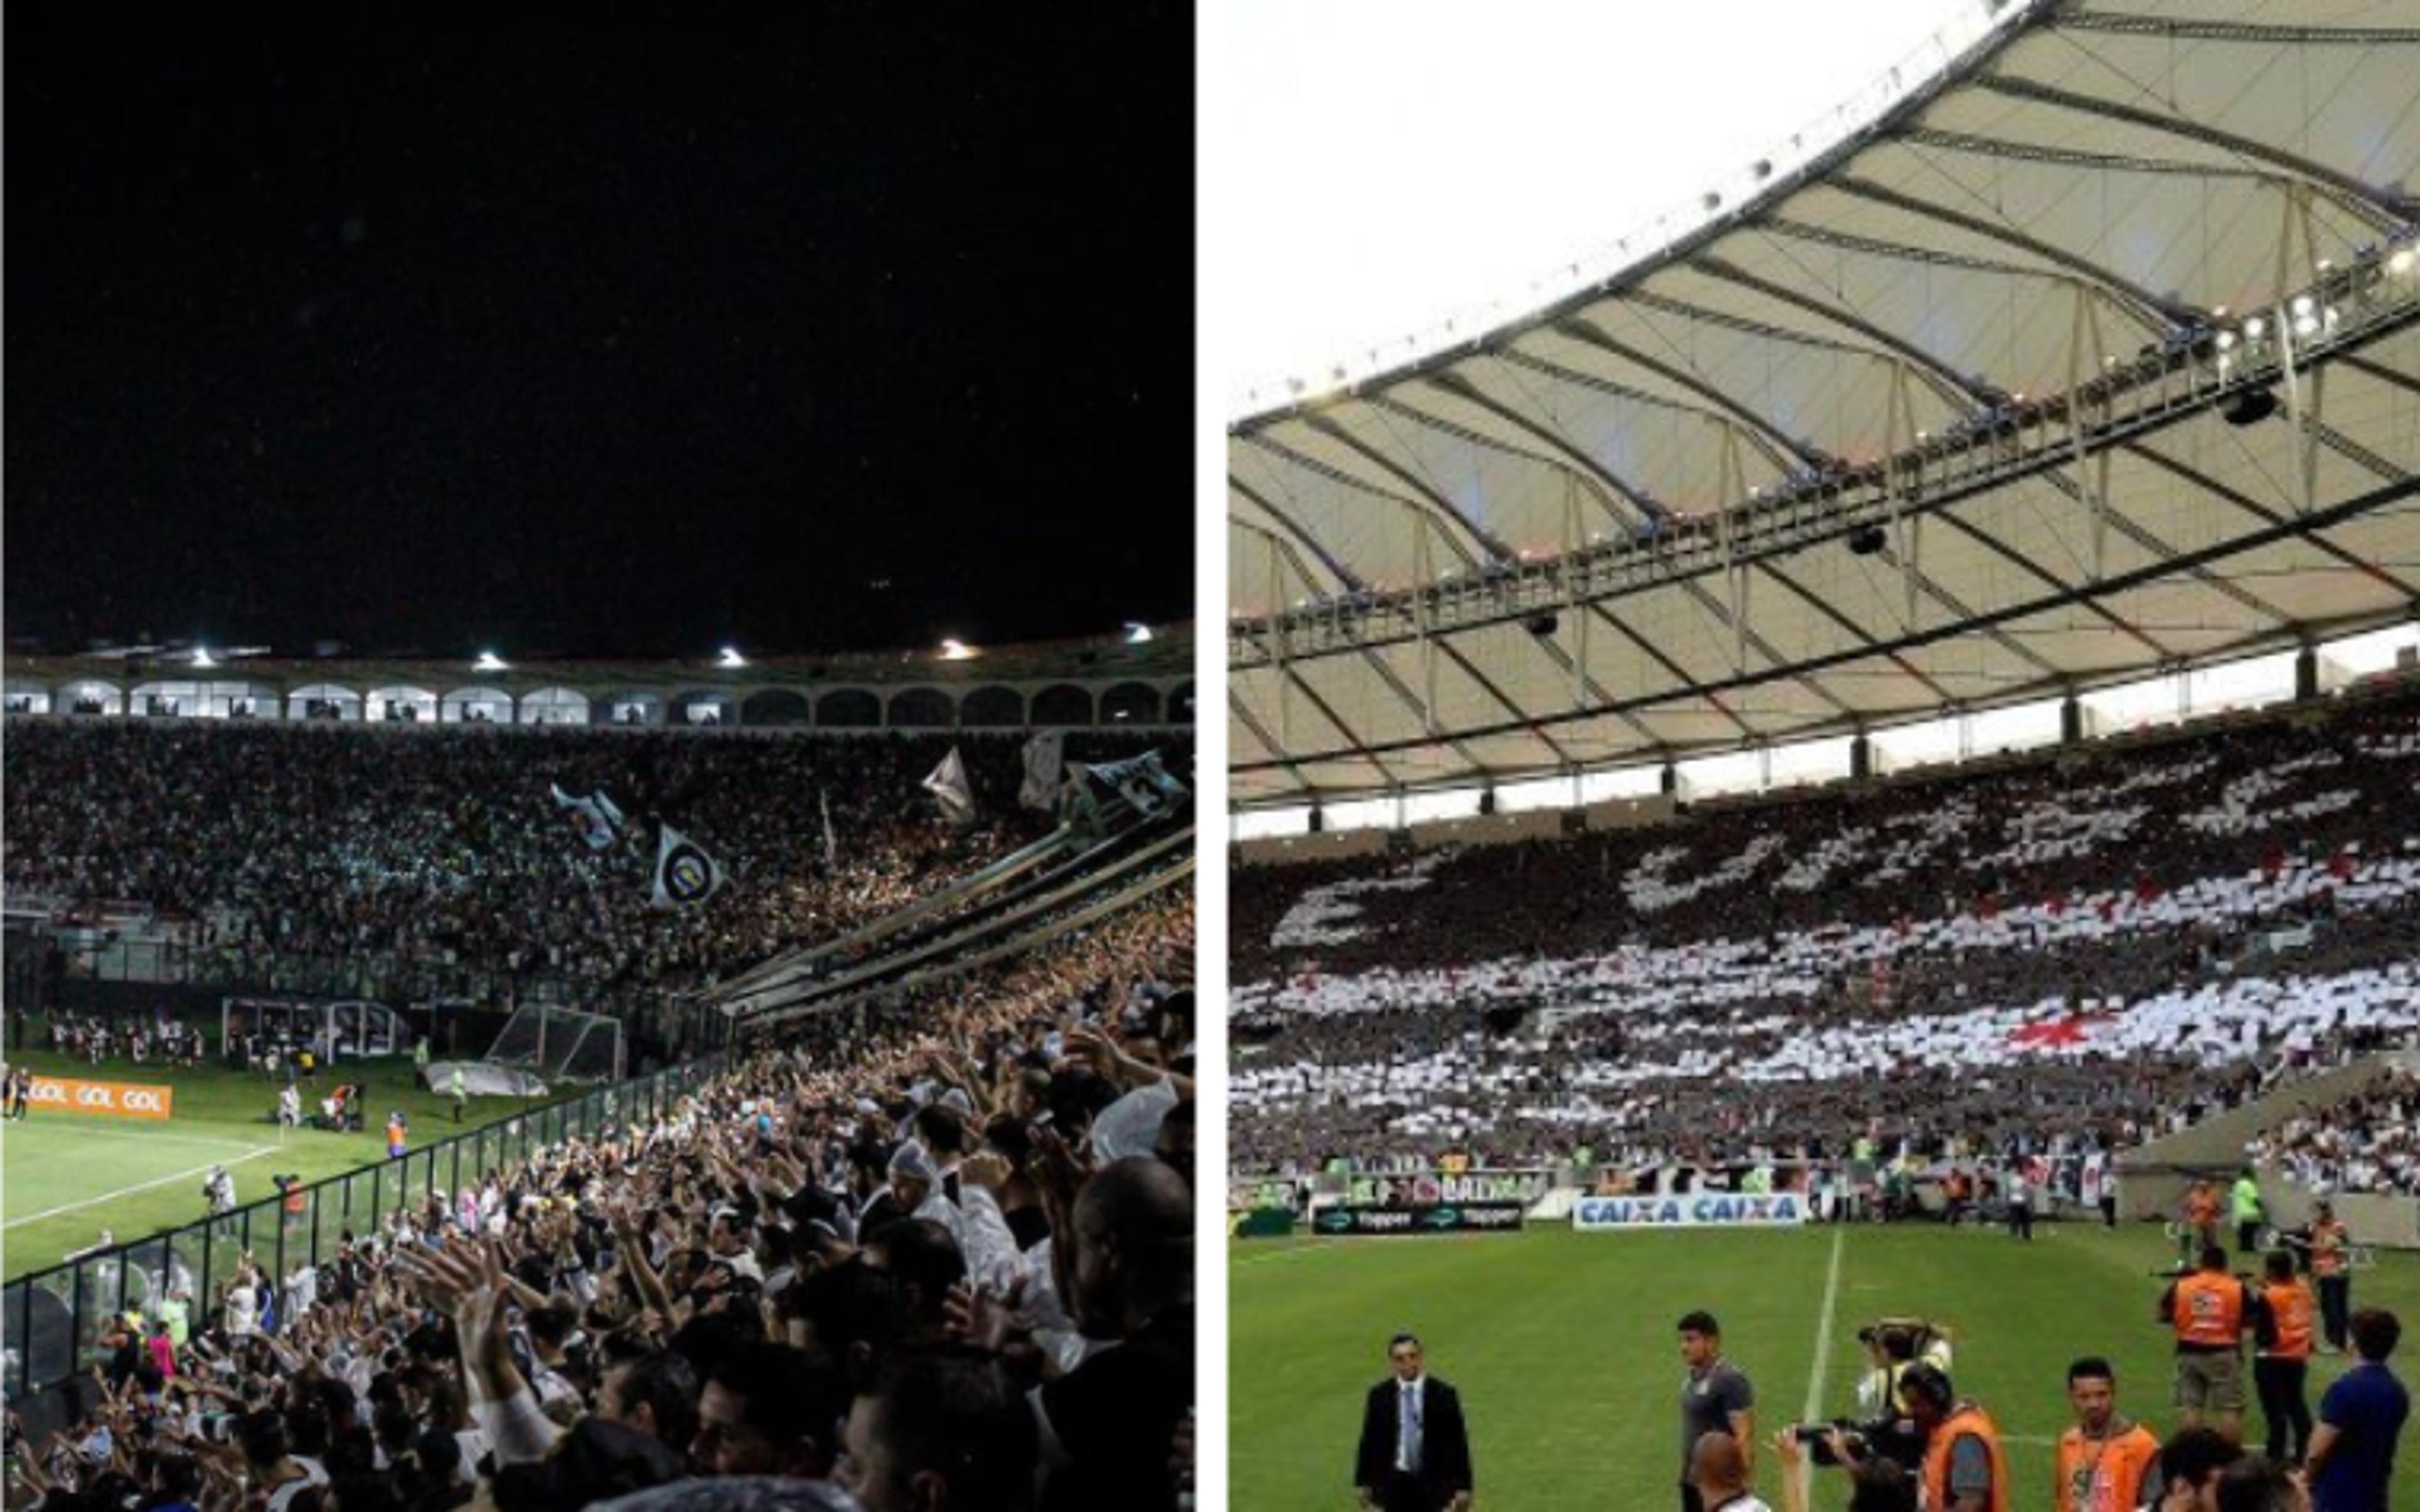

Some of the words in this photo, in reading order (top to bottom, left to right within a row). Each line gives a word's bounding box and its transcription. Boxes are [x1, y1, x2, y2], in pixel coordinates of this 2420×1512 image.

[28, 1082, 67, 1102] GOL
[76, 1085, 115, 1108] GOL
[122, 1089, 163, 1112] GOL
[1581, 1200, 1680, 1223] CAIXA
[1694, 1197, 1797, 1220] CAIXA
